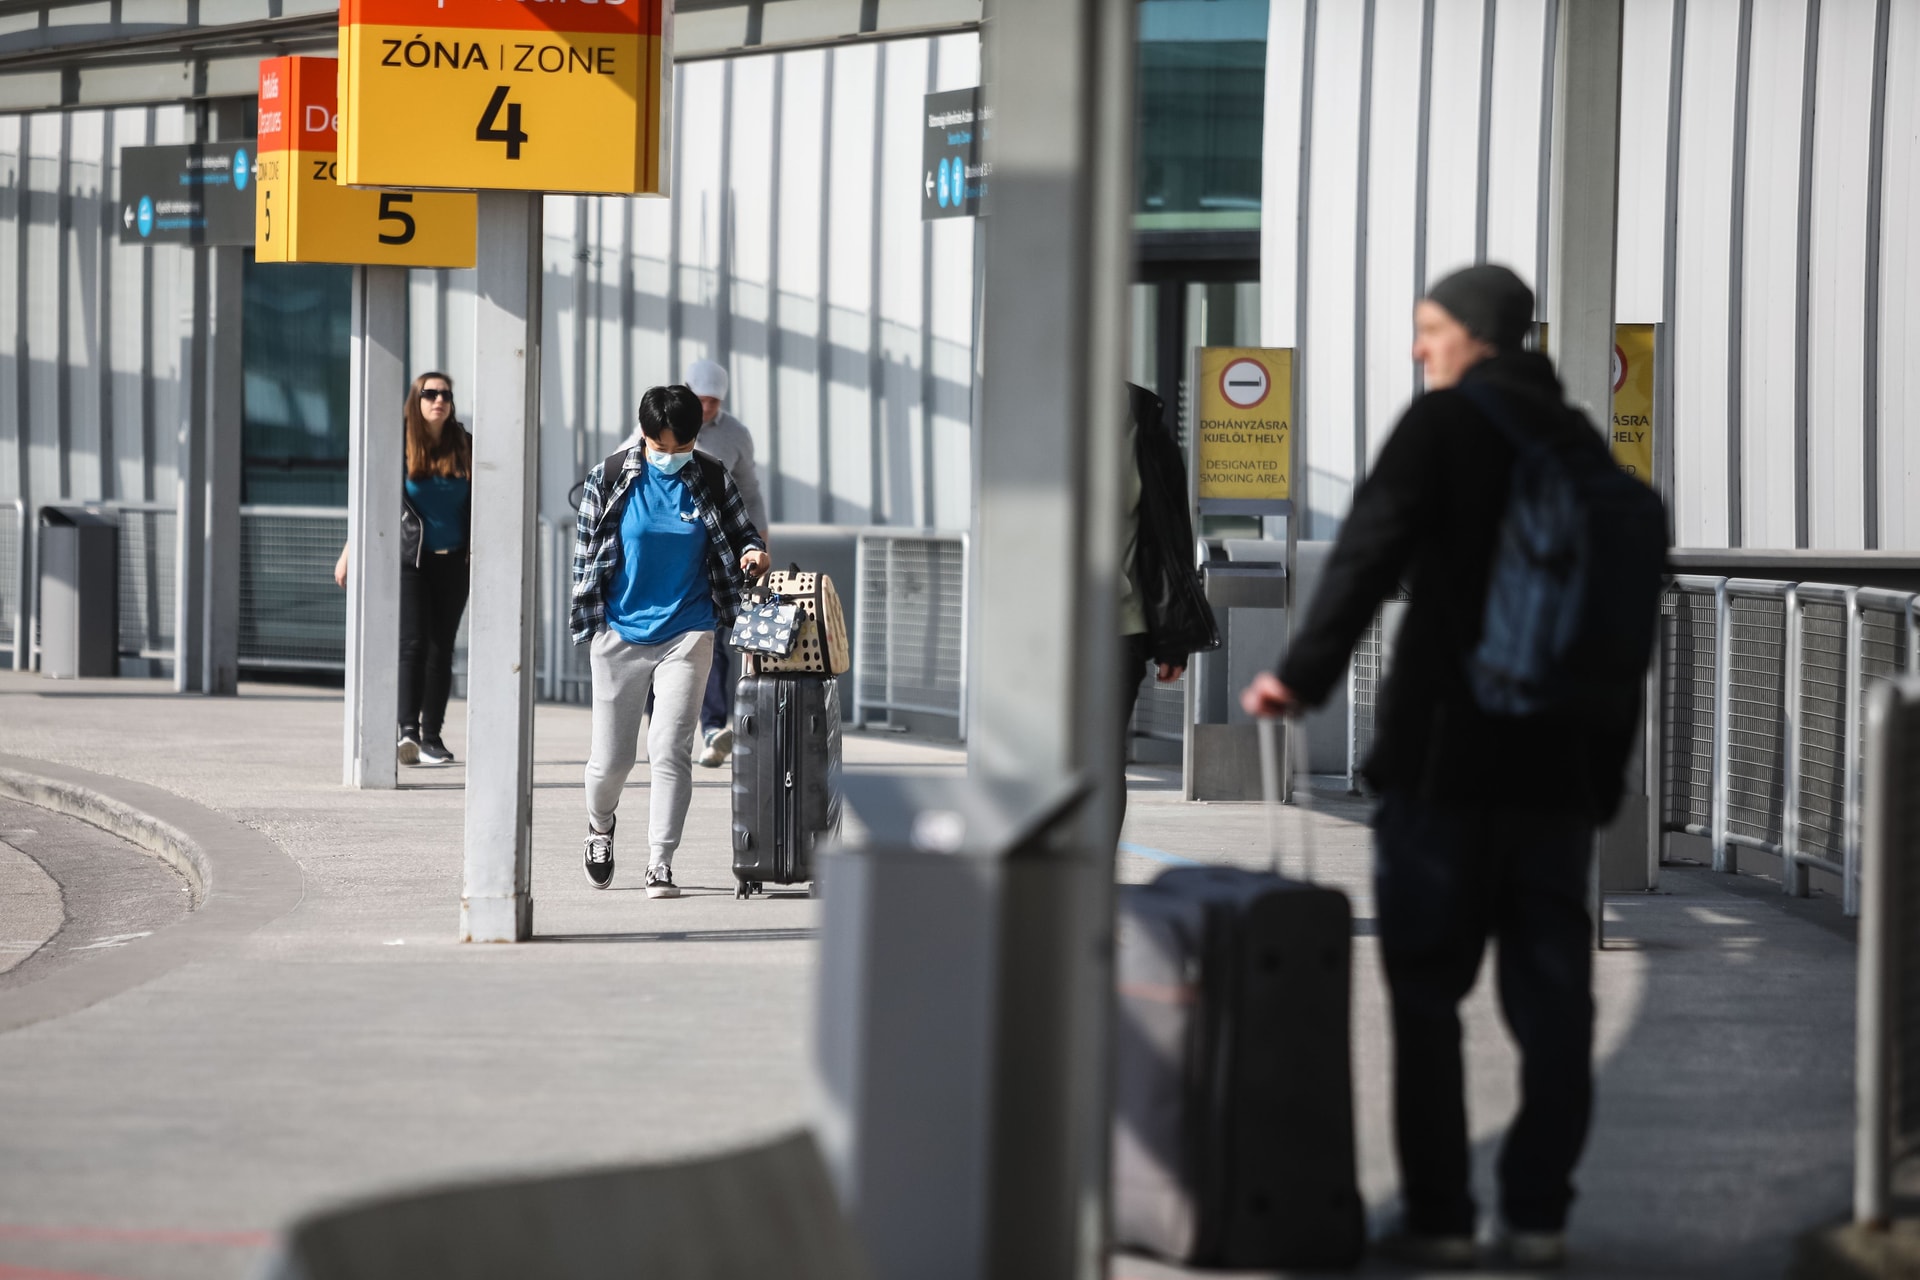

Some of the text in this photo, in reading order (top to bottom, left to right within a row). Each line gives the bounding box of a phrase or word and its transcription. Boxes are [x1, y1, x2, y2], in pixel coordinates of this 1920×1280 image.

[381, 34, 616, 75] ZÓNA ZONE
[476, 86, 529, 160] 4
[265, 190, 271, 242] 5
[377, 193, 416, 245] 5
[1200, 418, 1288, 430] DOHÁNYZÁSRA
[1255, 434, 1284, 443] HELY
[1206, 459, 1278, 470] DESIGNATED
[1200, 473, 1287, 484] SMOKING AREA
